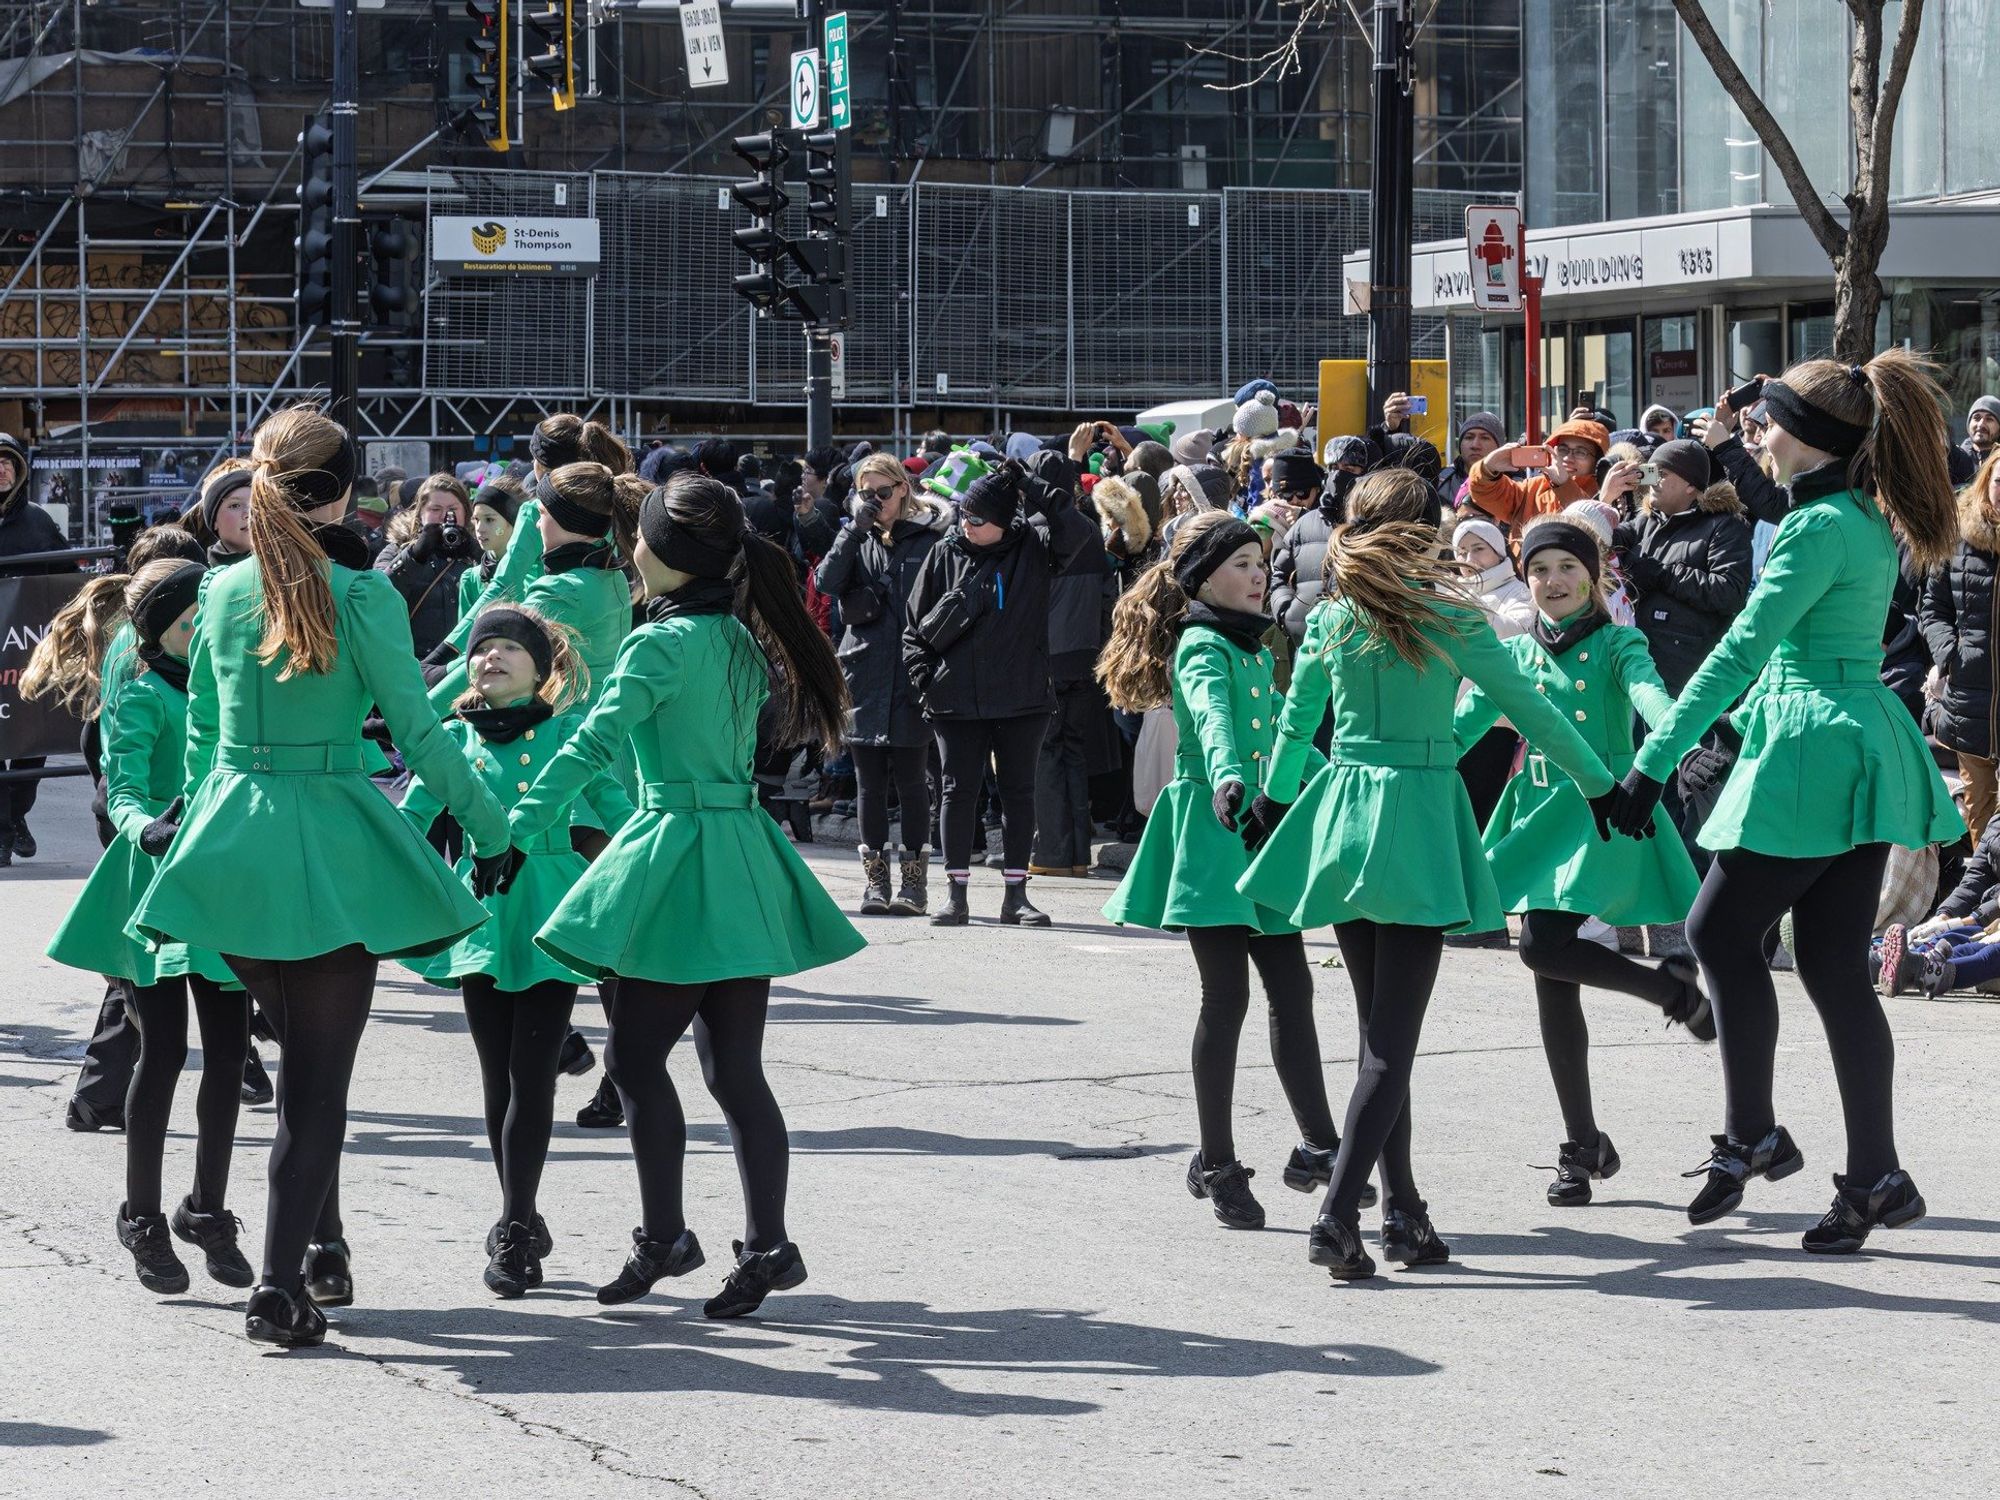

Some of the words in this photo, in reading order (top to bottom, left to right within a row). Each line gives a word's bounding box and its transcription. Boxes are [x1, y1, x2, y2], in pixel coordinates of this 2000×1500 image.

[829, 26, 844, 42] POLICE
[688, 37, 702, 55] LUN
[707, 34, 722, 52] VEN
[514, 228, 560, 238] St-Denis
[514, 240, 572, 251] Thompson
[463, 262, 507, 270] Restauration
[507, 262, 517, 270] de
[1558, 254, 1643, 286] BUILDING
[31, 459, 49, 469] JOUR
[50, 459, 60, 469] DE
[87, 459, 106, 469] JOUR
[106, 459, 116, 469] DE
[116, 458, 141, 468] MERDE
[1654, 610, 1669, 621] CAT
[3, 623, 53, 652] AN
